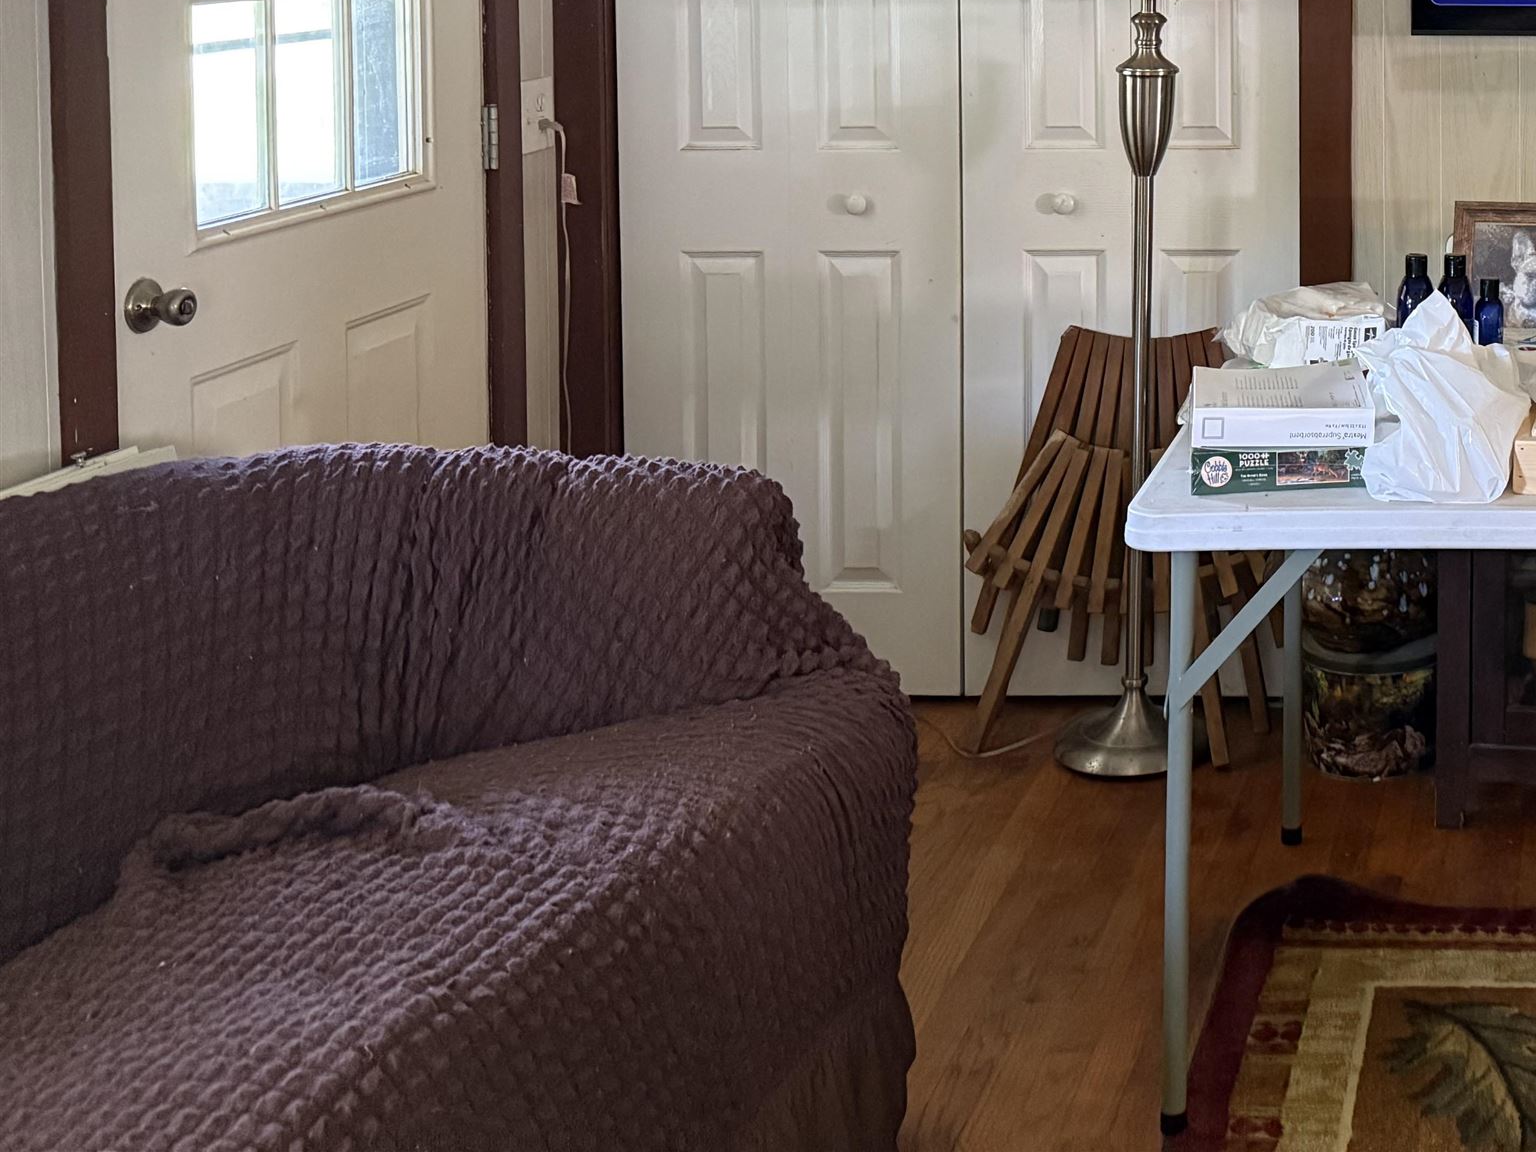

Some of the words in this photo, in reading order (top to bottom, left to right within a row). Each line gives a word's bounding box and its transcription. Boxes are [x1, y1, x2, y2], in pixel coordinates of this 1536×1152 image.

[1204, 460, 1228, 474] Cobble
[1239, 459, 1269, 467] PUZZLE
[1206, 472, 1221, 485] Hill
